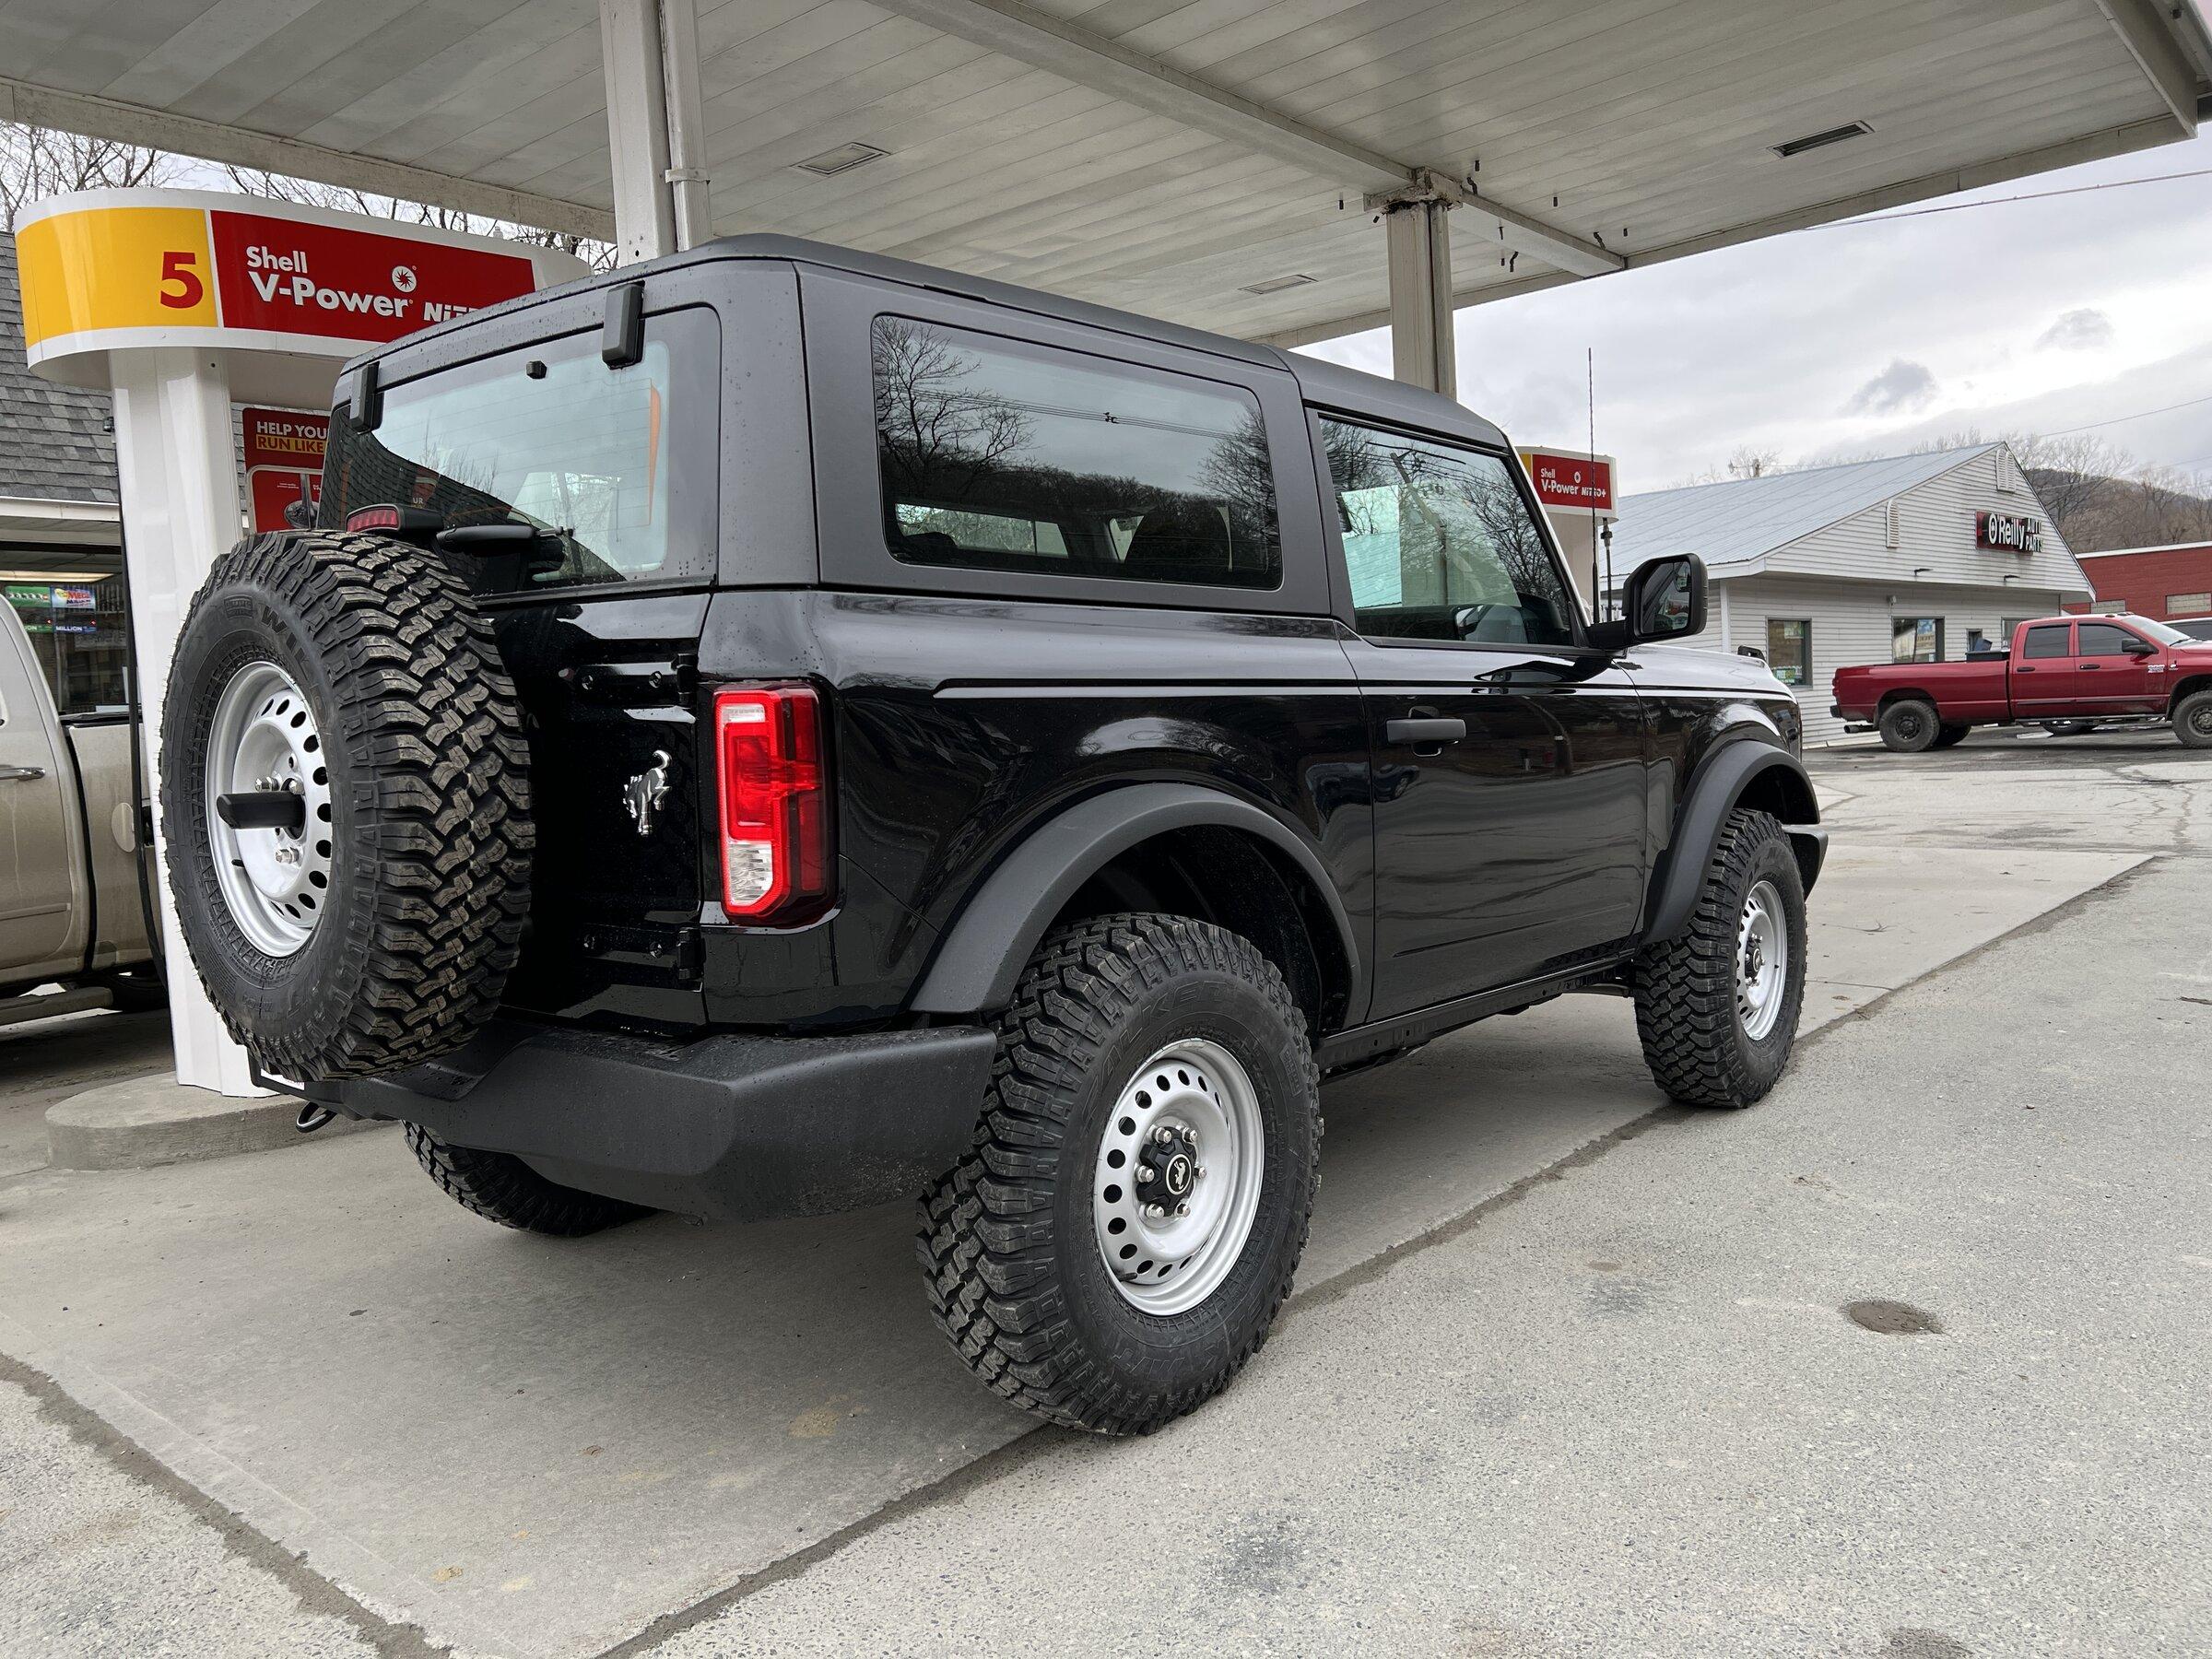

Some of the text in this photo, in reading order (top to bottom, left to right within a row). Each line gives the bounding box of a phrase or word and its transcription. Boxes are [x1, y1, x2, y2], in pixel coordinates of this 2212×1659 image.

[245, 245, 308, 274] Shell
[159, 252, 204, 310] 5
[247, 270, 479, 323] V-Power NiT
[256, 420, 292, 436] HELP
[257, 436, 324, 453] RUN LIKE
[1541, 467, 1555, 478] Shell
[1541, 478, 1579, 496] V-Power
[1988, 512, 2025, 550] O'Reilly
[2027, 517, 2041, 535] AUTO
[2025, 535, 2043, 553] PARTS
